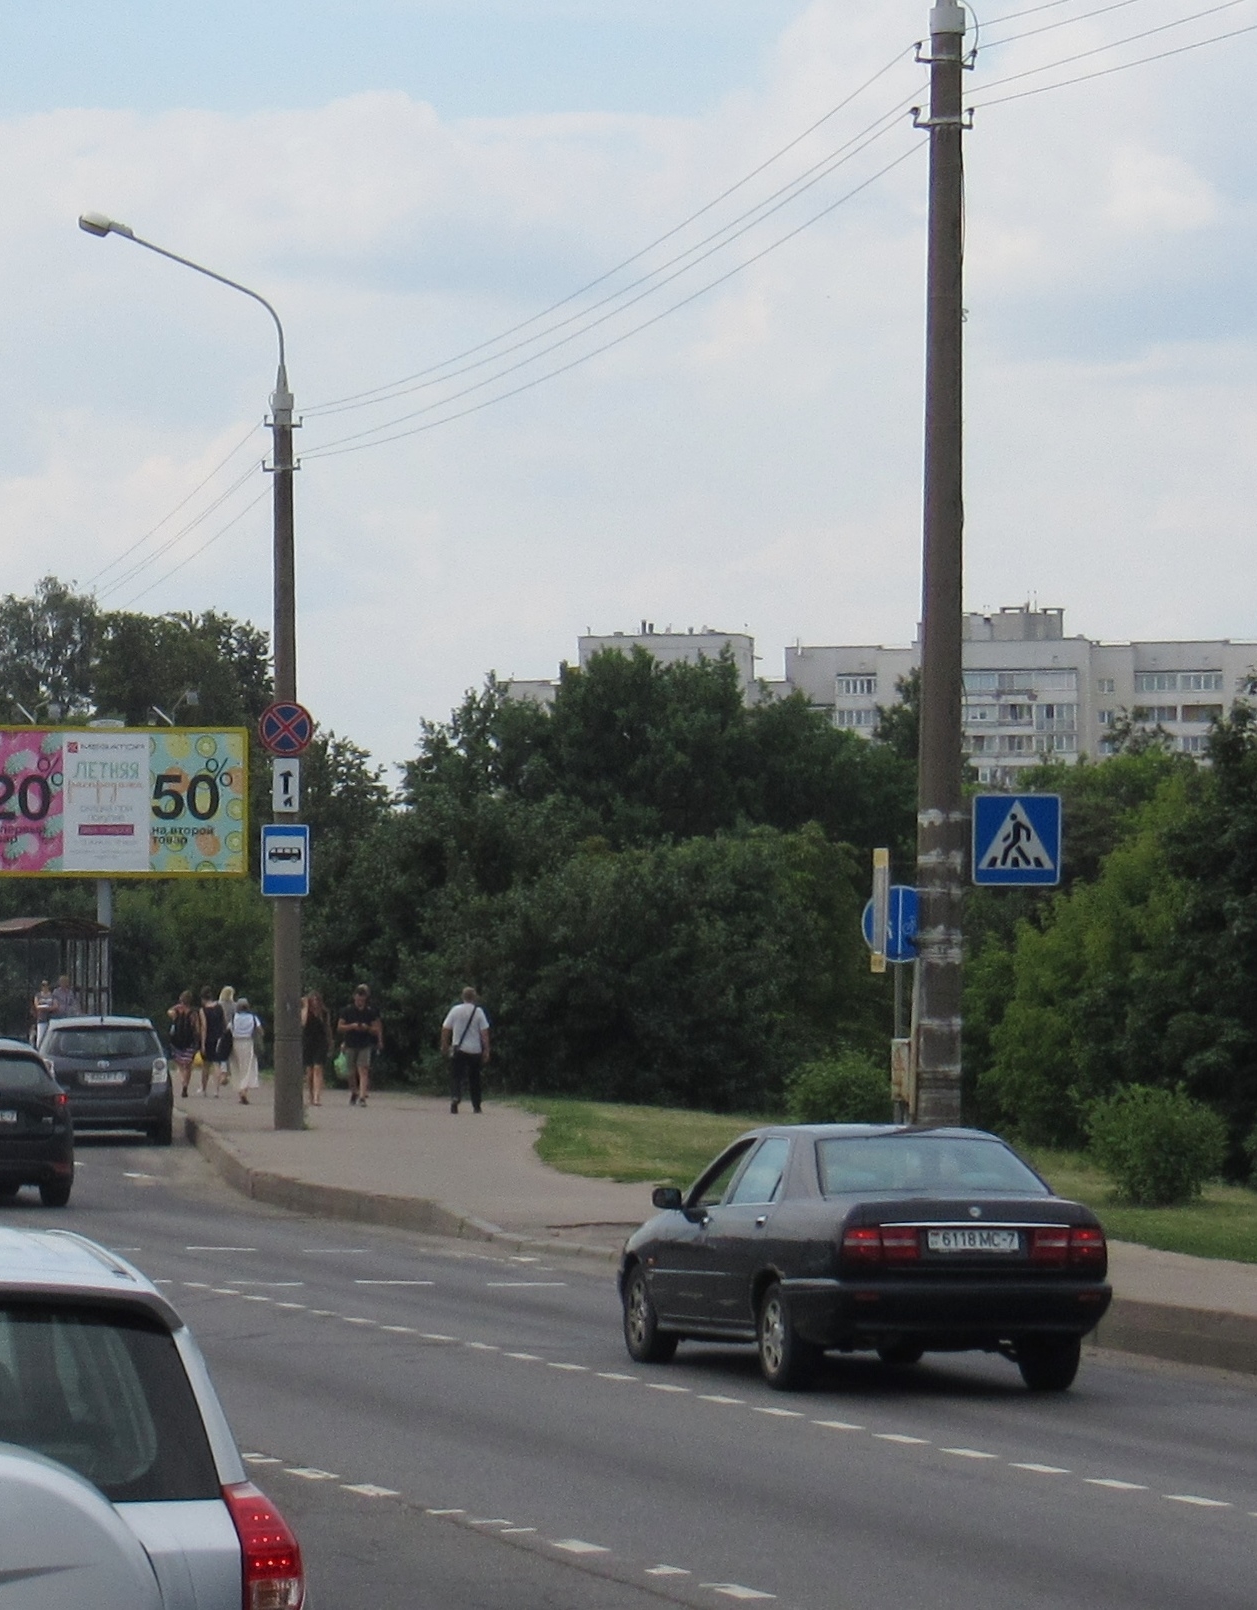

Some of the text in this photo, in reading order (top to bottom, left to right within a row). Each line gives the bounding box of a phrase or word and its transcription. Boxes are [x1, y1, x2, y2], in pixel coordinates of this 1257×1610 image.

[72, 761, 140, 779] ЛЕТНЯЯ
[151, 825, 215, 838] на второй
[152, 836, 188, 846] товар
[942, 1231, 976, 1247] 6118
[979, 1231, 1015, 1247] MC-7
